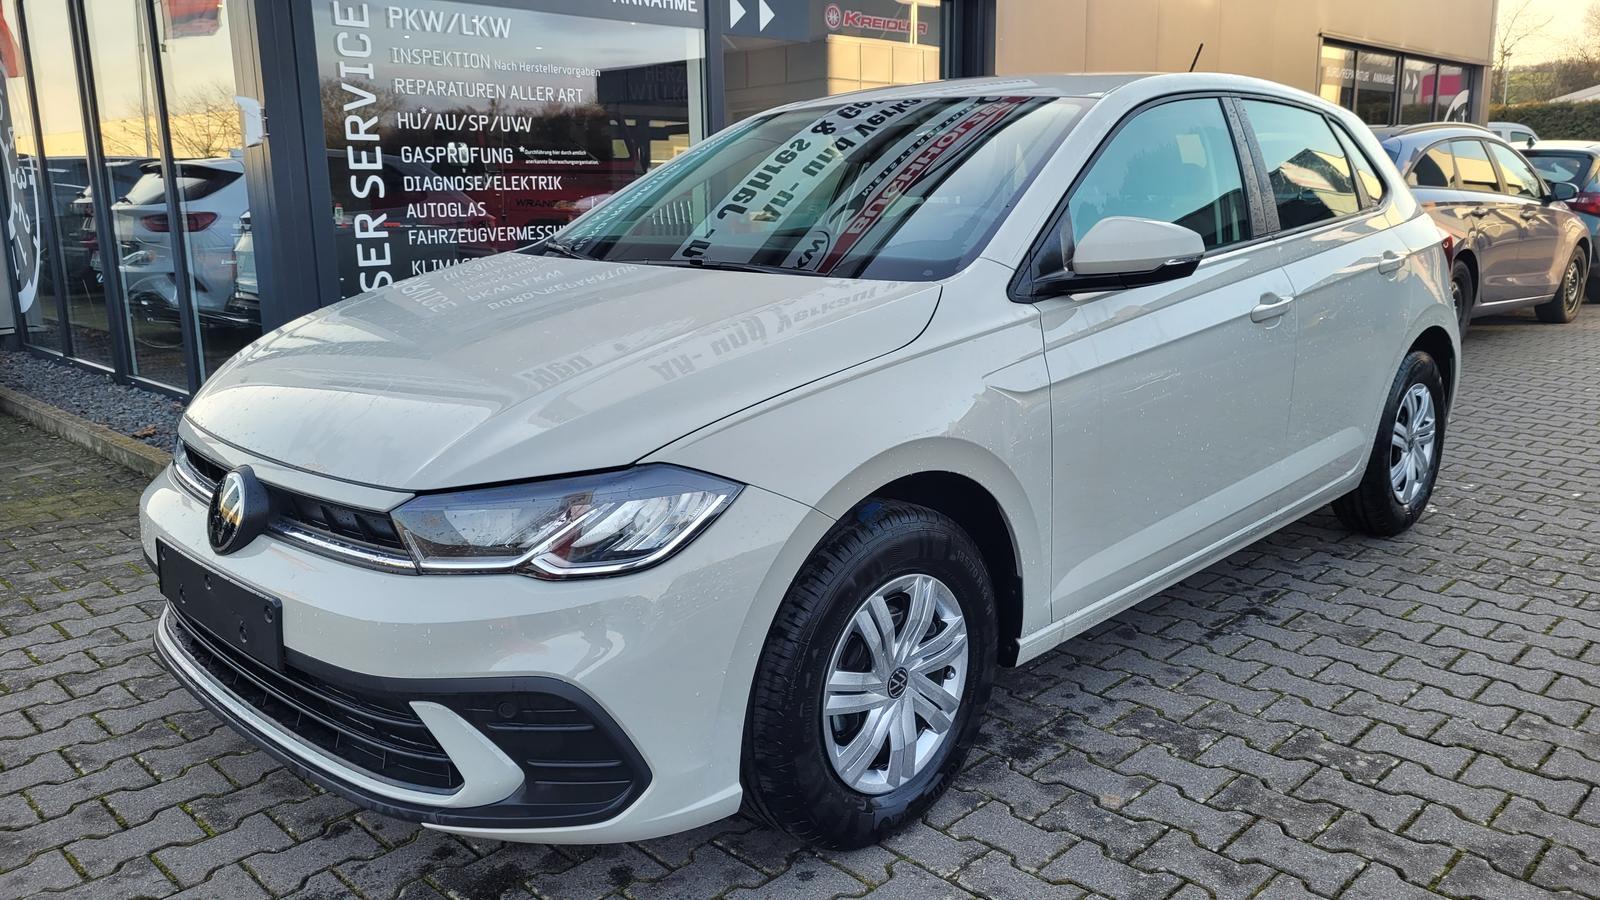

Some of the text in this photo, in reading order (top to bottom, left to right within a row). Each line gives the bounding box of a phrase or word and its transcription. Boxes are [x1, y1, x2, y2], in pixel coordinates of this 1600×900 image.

[612, 0, 698, 12] AHME
[388, 7, 511, 38] PKW/LKW
[392, 48, 600, 78] INSPEKTION Nach Herstellervorgaben
[333, 0, 385, 199] SERVICE
[394, 78, 583, 103] REPARATUREN ALLER ART
[401, 143, 513, 165] GASPRÜFUNG
[403, 175, 562, 191] DIAGNOSE/ELEKTRIK
[406, 202, 487, 218] AUTOGLAS
[408, 225, 569, 245] FAHRZEUGVERMESS
